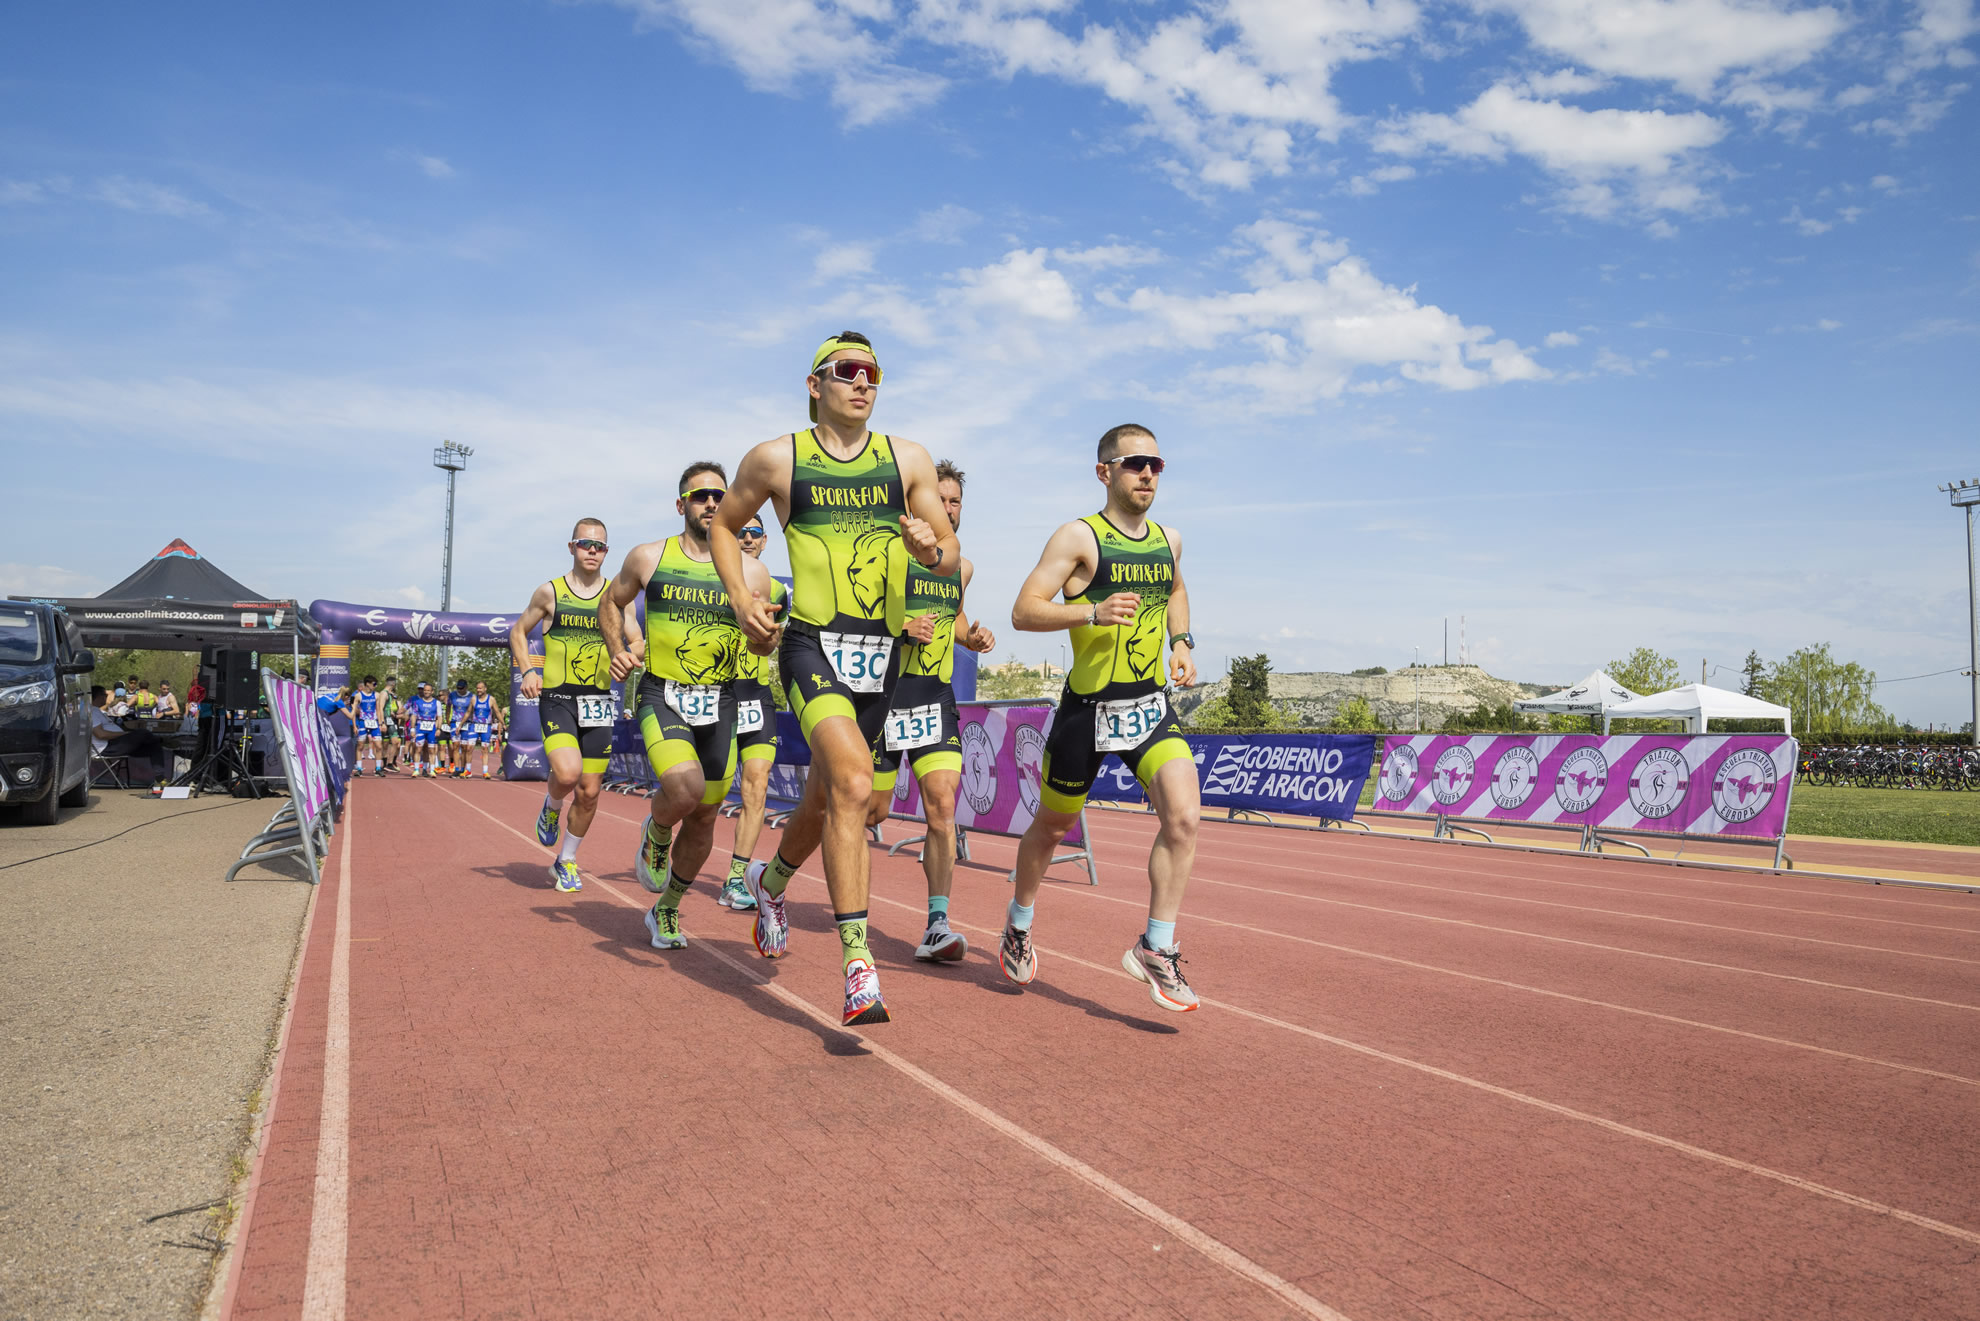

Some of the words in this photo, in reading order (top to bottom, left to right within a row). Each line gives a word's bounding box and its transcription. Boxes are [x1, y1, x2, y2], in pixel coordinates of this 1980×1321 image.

[811, 483, 888, 508] SPORT&FUN
[831, 510, 877, 534] GURREA
[1110, 562, 1173, 584] SPORT&FUN
[913, 578, 960, 600] SPORT&FUN
[85, 609, 224, 621] www.cronolimits2020.com
[668, 605, 725, 626] LARROY
[432, 622, 461, 634] LIGA
[832, 649, 886, 679] 13C
[582, 703, 613, 719] 13A
[675, 692, 715, 716] 13E
[895, 715, 937, 741] 13F
[1107, 708, 1162, 738] 13B
[1243, 745, 1343, 774] GOBIERNO
[1719, 752, 1746, 778] ESCUELA
[1231, 771, 1260, 794] DE
[1259, 773, 1354, 803] ARAGON
[1437, 792, 1460, 804] EUROPA
[1496, 794, 1522, 808] EUROPA
[1562, 798, 1590, 811] EUROPA
[1638, 801, 1672, 817] EUROPA
[1721, 805, 1756, 821] EUROPA
